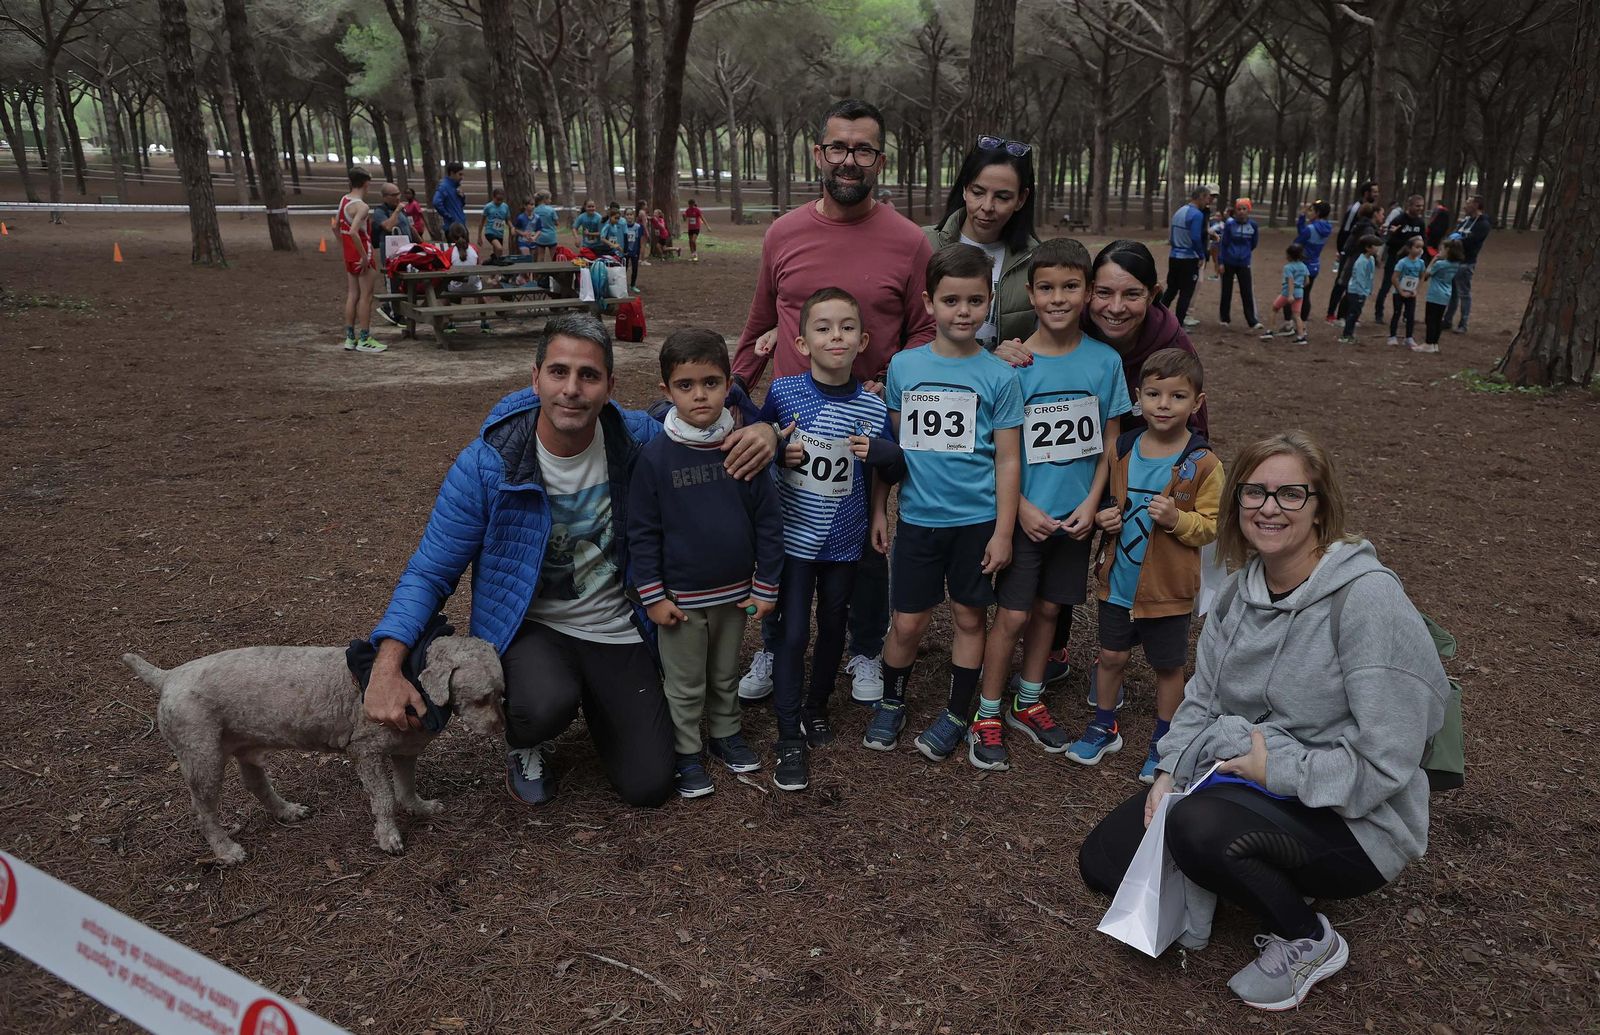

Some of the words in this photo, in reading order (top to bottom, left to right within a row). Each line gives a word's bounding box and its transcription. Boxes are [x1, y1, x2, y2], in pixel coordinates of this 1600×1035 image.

[911, 394, 940, 402] CROSS
[1034, 404, 1070, 415] CROSS
[907, 409, 965, 438] 193
[1031, 415, 1094, 448] 220
[801, 434, 833, 451] CROSS
[671, 462, 727, 489] BENETT
[792, 449, 849, 482] 202
